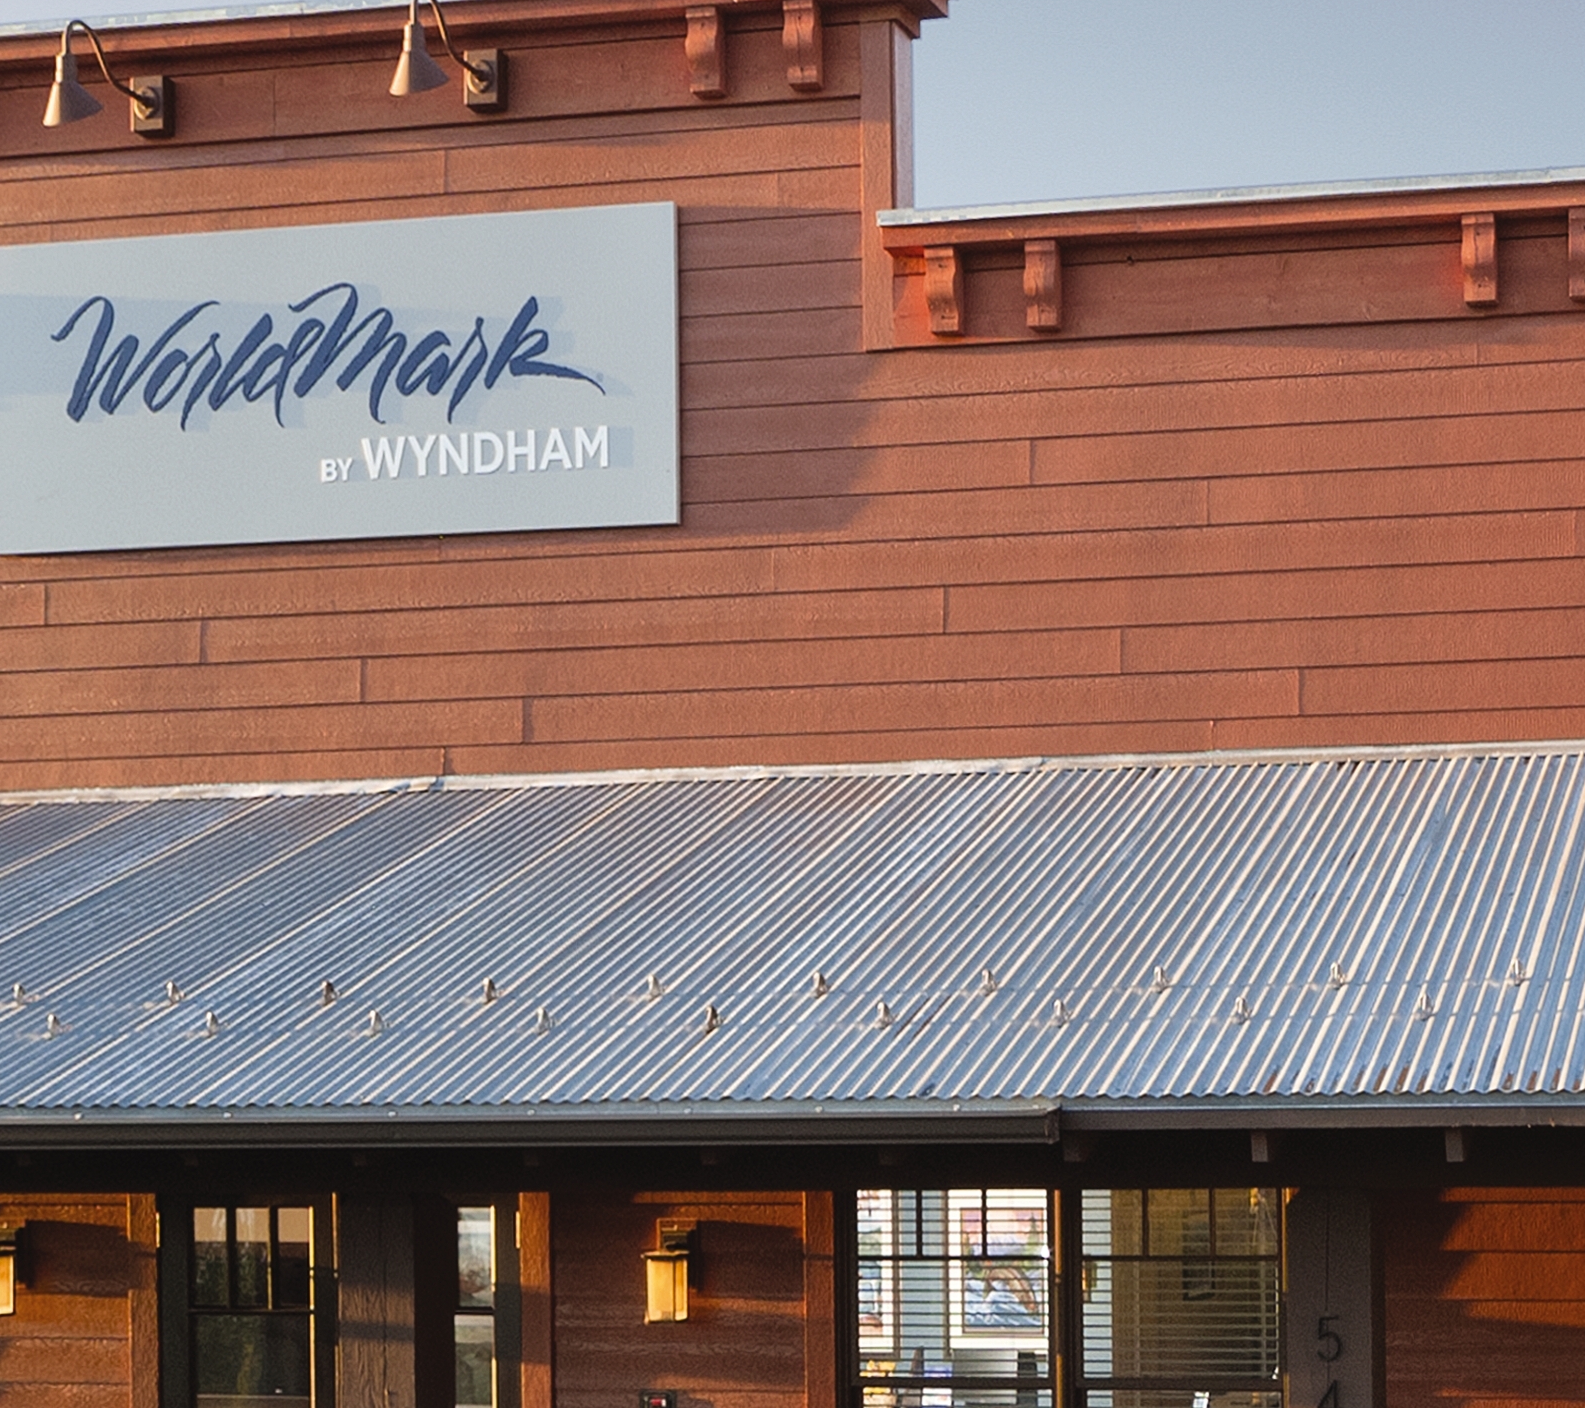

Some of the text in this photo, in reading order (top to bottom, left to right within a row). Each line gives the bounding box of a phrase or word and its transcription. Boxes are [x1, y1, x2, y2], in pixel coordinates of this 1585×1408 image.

[51, 282, 607, 430] WorldMark
[319, 425, 610, 483] BY WYNDHAM
